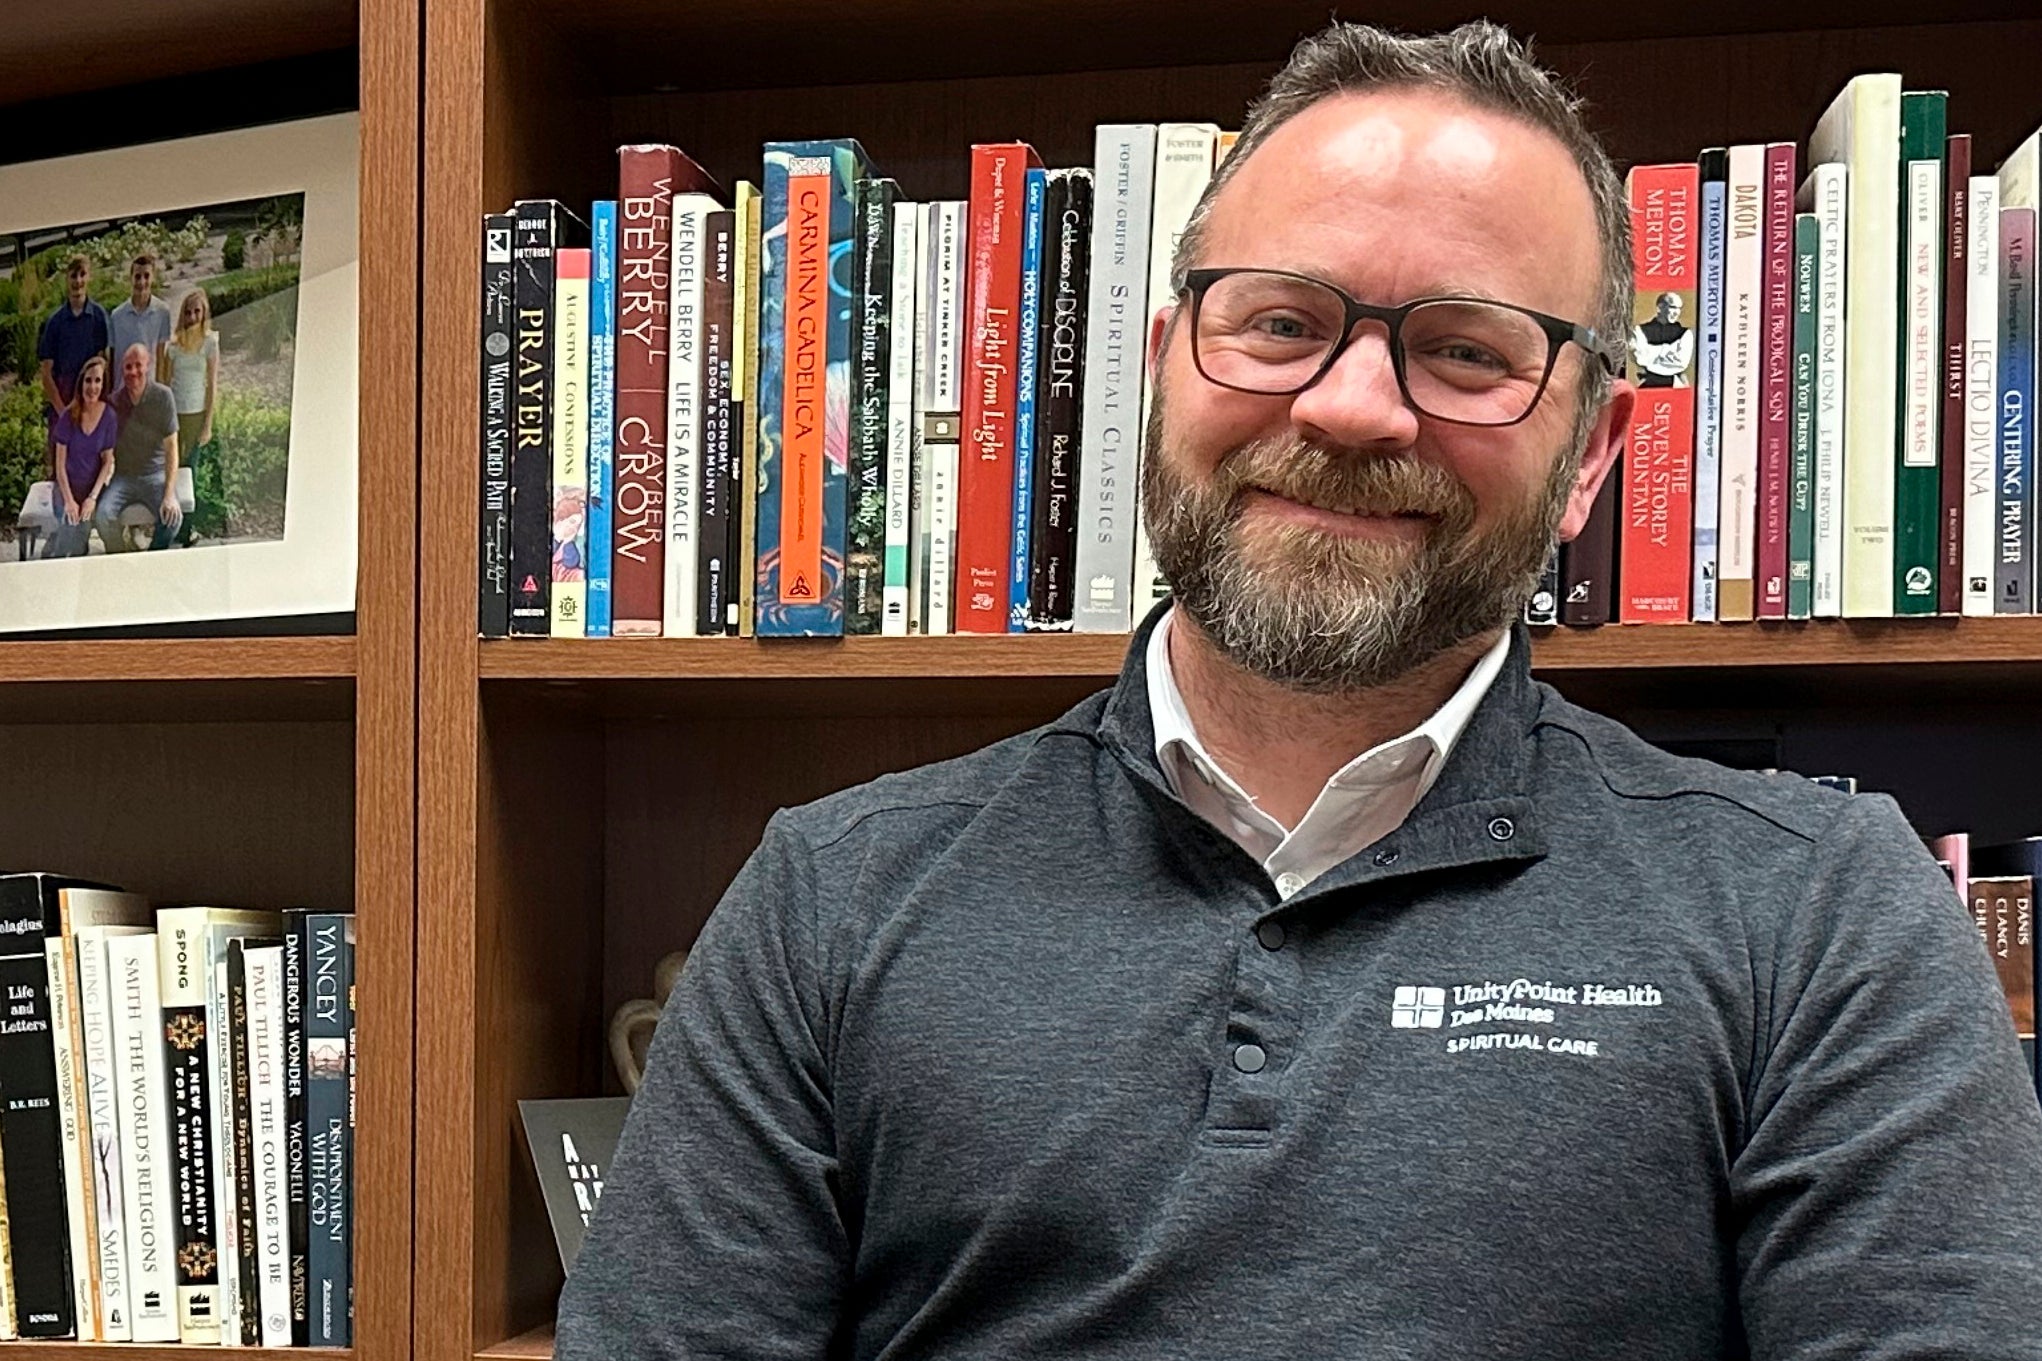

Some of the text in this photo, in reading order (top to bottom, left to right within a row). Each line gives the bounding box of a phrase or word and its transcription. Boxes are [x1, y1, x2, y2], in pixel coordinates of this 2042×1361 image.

[942, 214, 953, 271] PILGRIM
[1113, 143, 1131, 266] FOSTER GRIFFIN
[1644, 189, 1664, 276] MERTON
[1667, 185, 1688, 276] THOMAS
[1733, 185, 1758, 240] DAKOTA
[621, 197, 655, 345] BERRY
[648, 176, 672, 365] WENDELL
[677, 212, 696, 299] WENDELL
[716, 231, 729, 284] BERRY
[942, 277, 952, 293] AT
[1058, 210, 1080, 294] Celebration of
[1768, 160, 1788, 422] THE RETURN OF THE PRODIGAL SON
[1799, 254, 1813, 313] NOUWEN
[1821, 177, 1839, 413] CELTIC PRAYERS FROM IONA
[676, 304, 693, 363] BERRY
[794, 190, 820, 440] CARMINA GADELICA
[899, 294, 912, 332] Stone
[940, 299, 951, 348] TINKER
[1018, 270, 1036, 402] HOLY COMPANIONS
[1050, 299, 1078, 399] DISCIPLINE
[1704, 196, 1721, 458] THOMAS MERTON Prayer
[1914, 172, 1929, 454] OLIVER NEW AND SELECTED POEMS
[1968, 190, 1993, 498] PENNINGTON LECTIO DIVINA
[486, 361, 509, 414] WALKING
[518, 308, 545, 450] PRAYER
[563, 293, 579, 474] AUGUSTINE CONFESSIONS
[674, 381, 692, 417] LIFE
[972, 307, 1010, 462] Light from Light
[1735, 293, 1749, 431] KATHLEEN NORRIS
[1797, 382, 1811, 409] YOU
[1798, 353, 1811, 381] CAN
[1949, 342, 1962, 400] THIRST
[486, 429, 509, 476] SACRED
[588, 334, 604, 497] SPIRITUAL DIRECTION
[673, 446, 689, 458] A
[674, 424, 690, 440] IS
[704, 323, 720, 518] FREEDOM & COMMUNITY
[716, 359, 731, 477] SEX, ECONOMY,
[856, 294, 884, 527] Keeping the Sabbath Wholly
[1097, 284, 1129, 544] SPIRITUAL CLASSICS
[1796, 411, 1810, 451] DRINK
[2002, 390, 2023, 494] CENTERING
[485, 480, 508, 510] PATH
[616, 416, 651, 564] CROW
[644, 436, 666, 544] JAYBER
[672, 463, 689, 543] MIRACLE
[891, 417, 905, 529] ANNIE DILLARD
[1049, 434, 1070, 528] Richard J. Foster
[1632, 422, 1652, 528] MOUNTAIN
[1651, 402, 1671, 547] SEVEN STOREY
[1671, 455, 1689, 494] THE
[1796, 453, 1808, 478] THE
[1818, 440, 1831, 543] PHILIP NEWELL
[933, 471, 946, 610] annie dillard
[2002, 500, 2022, 564] PRAYER
[0, 918, 44, 936] elagius
[175, 928, 189, 989] SPONG
[1995, 898, 2008, 958] CLANCY
[7, 984, 35, 1000] Life
[10, 1001, 35, 1016] and
[252, 964, 268, 1008] PAUL
[315, 925, 338, 1024] YANCEY
[1449, 1002, 1555, 1028] Des Moines
[1452, 978, 1663, 1007] UnityPoint Health
[0, 1018, 48, 1034] Letters
[83, 939, 112, 1131] KEEPING HOPE ALIVE
[254, 1015, 272, 1086] TILLICH
[285, 933, 304, 1203] DANGEROUS WONDER YACONELLI
[1446, 1032, 1600, 1057] SPIRITUAL CARE
[66, 1117, 76, 1142] GOD
[124, 957, 158, 1273] SMITH THE WORLD'S RELIGIONS
[174, 1066, 192, 1226] FOR A NEW WORLD
[188, 1055, 208, 1236] A NEW CHRISTIANITY
[233, 985, 254, 1257] PAUL TILLICH Dynamics of Faith
[260, 1098, 274, 1135] THE
[261, 1140, 281, 1226] COURAGE
[311, 1132, 327, 1226] WITH GOD
[328, 1118, 343, 1244] DISAPPOINTMENT
[102, 1229, 121, 1298] SMEDES
[266, 1231, 281, 1256] TO
[268, 1262, 282, 1284] BE
